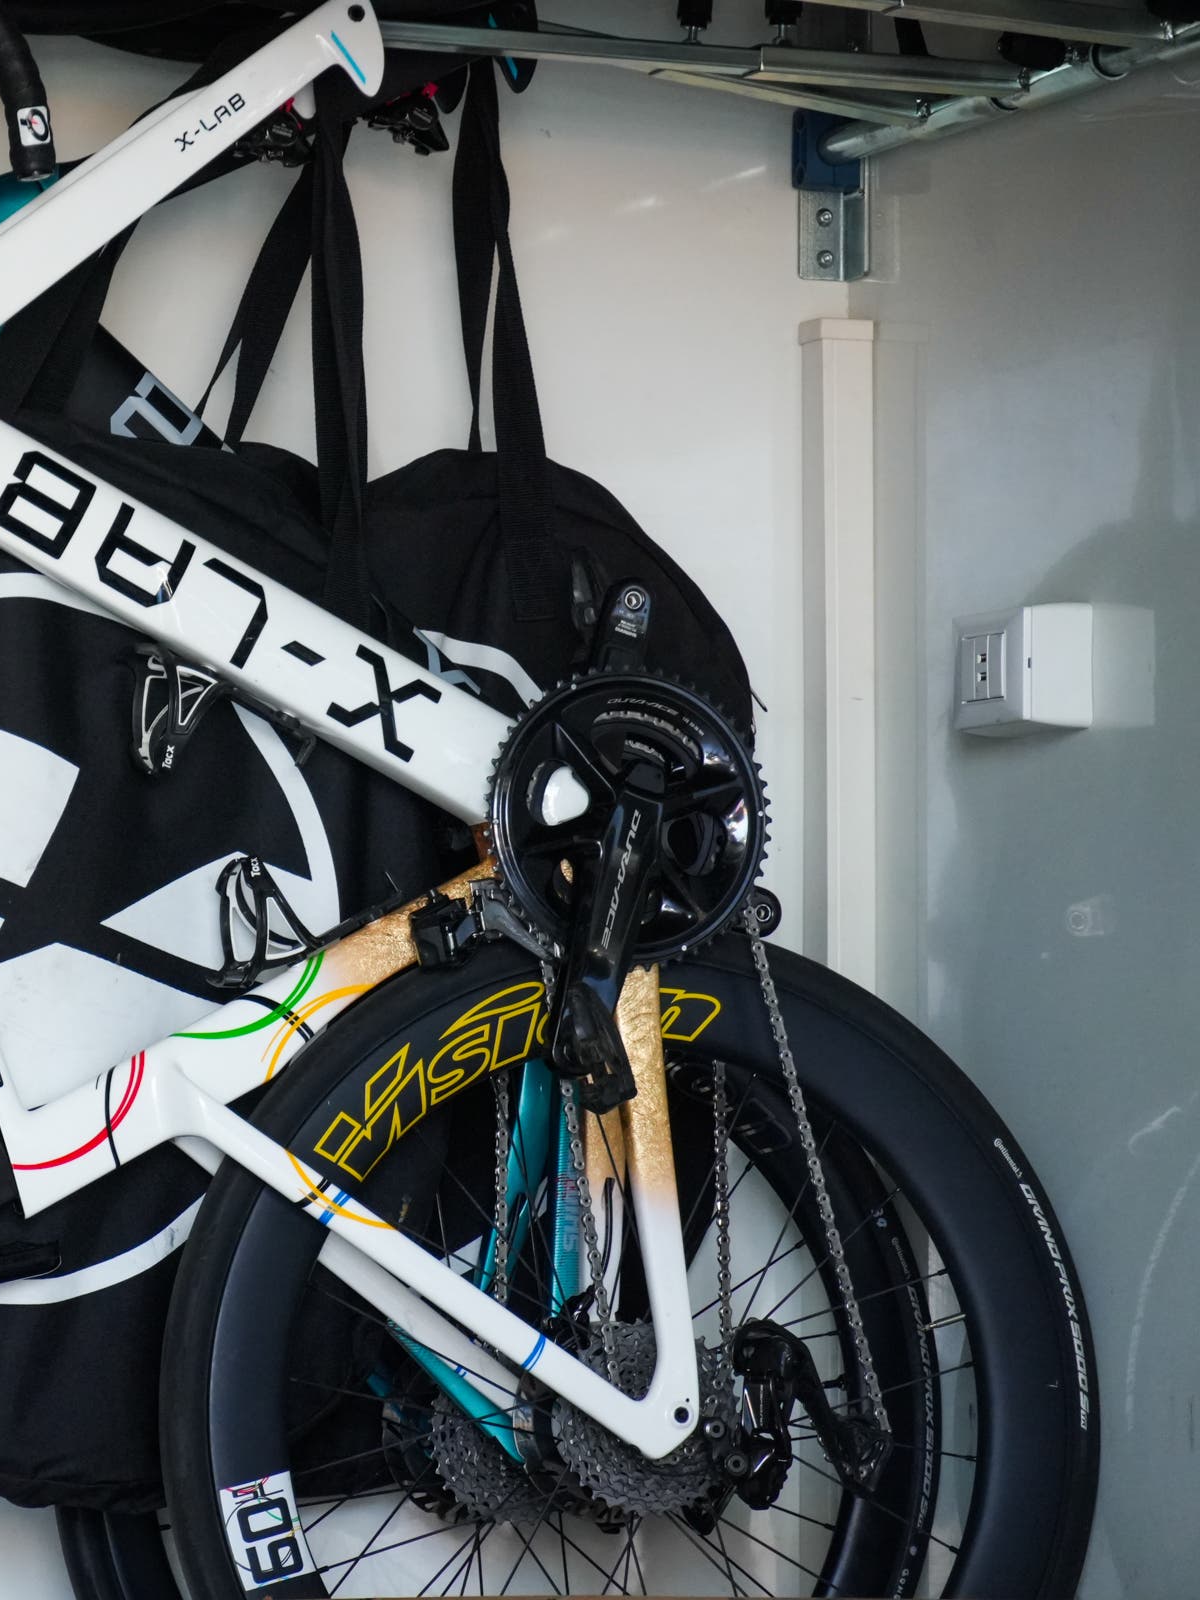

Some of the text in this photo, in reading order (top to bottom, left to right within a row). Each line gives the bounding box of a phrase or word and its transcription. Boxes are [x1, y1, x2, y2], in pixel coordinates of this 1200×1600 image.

[174, 92, 246, 152] X-LAB
[161, 744, 176, 769] Tacx
[601, 809, 642, 950] DURA-ACE
[993, 1137, 1021, 1176] Continental
[1019, 1183, 1062, 1261] GRAND
[1054, 1260, 1079, 1321] PRIX
[1070, 1320, 1089, 1393] 5000
